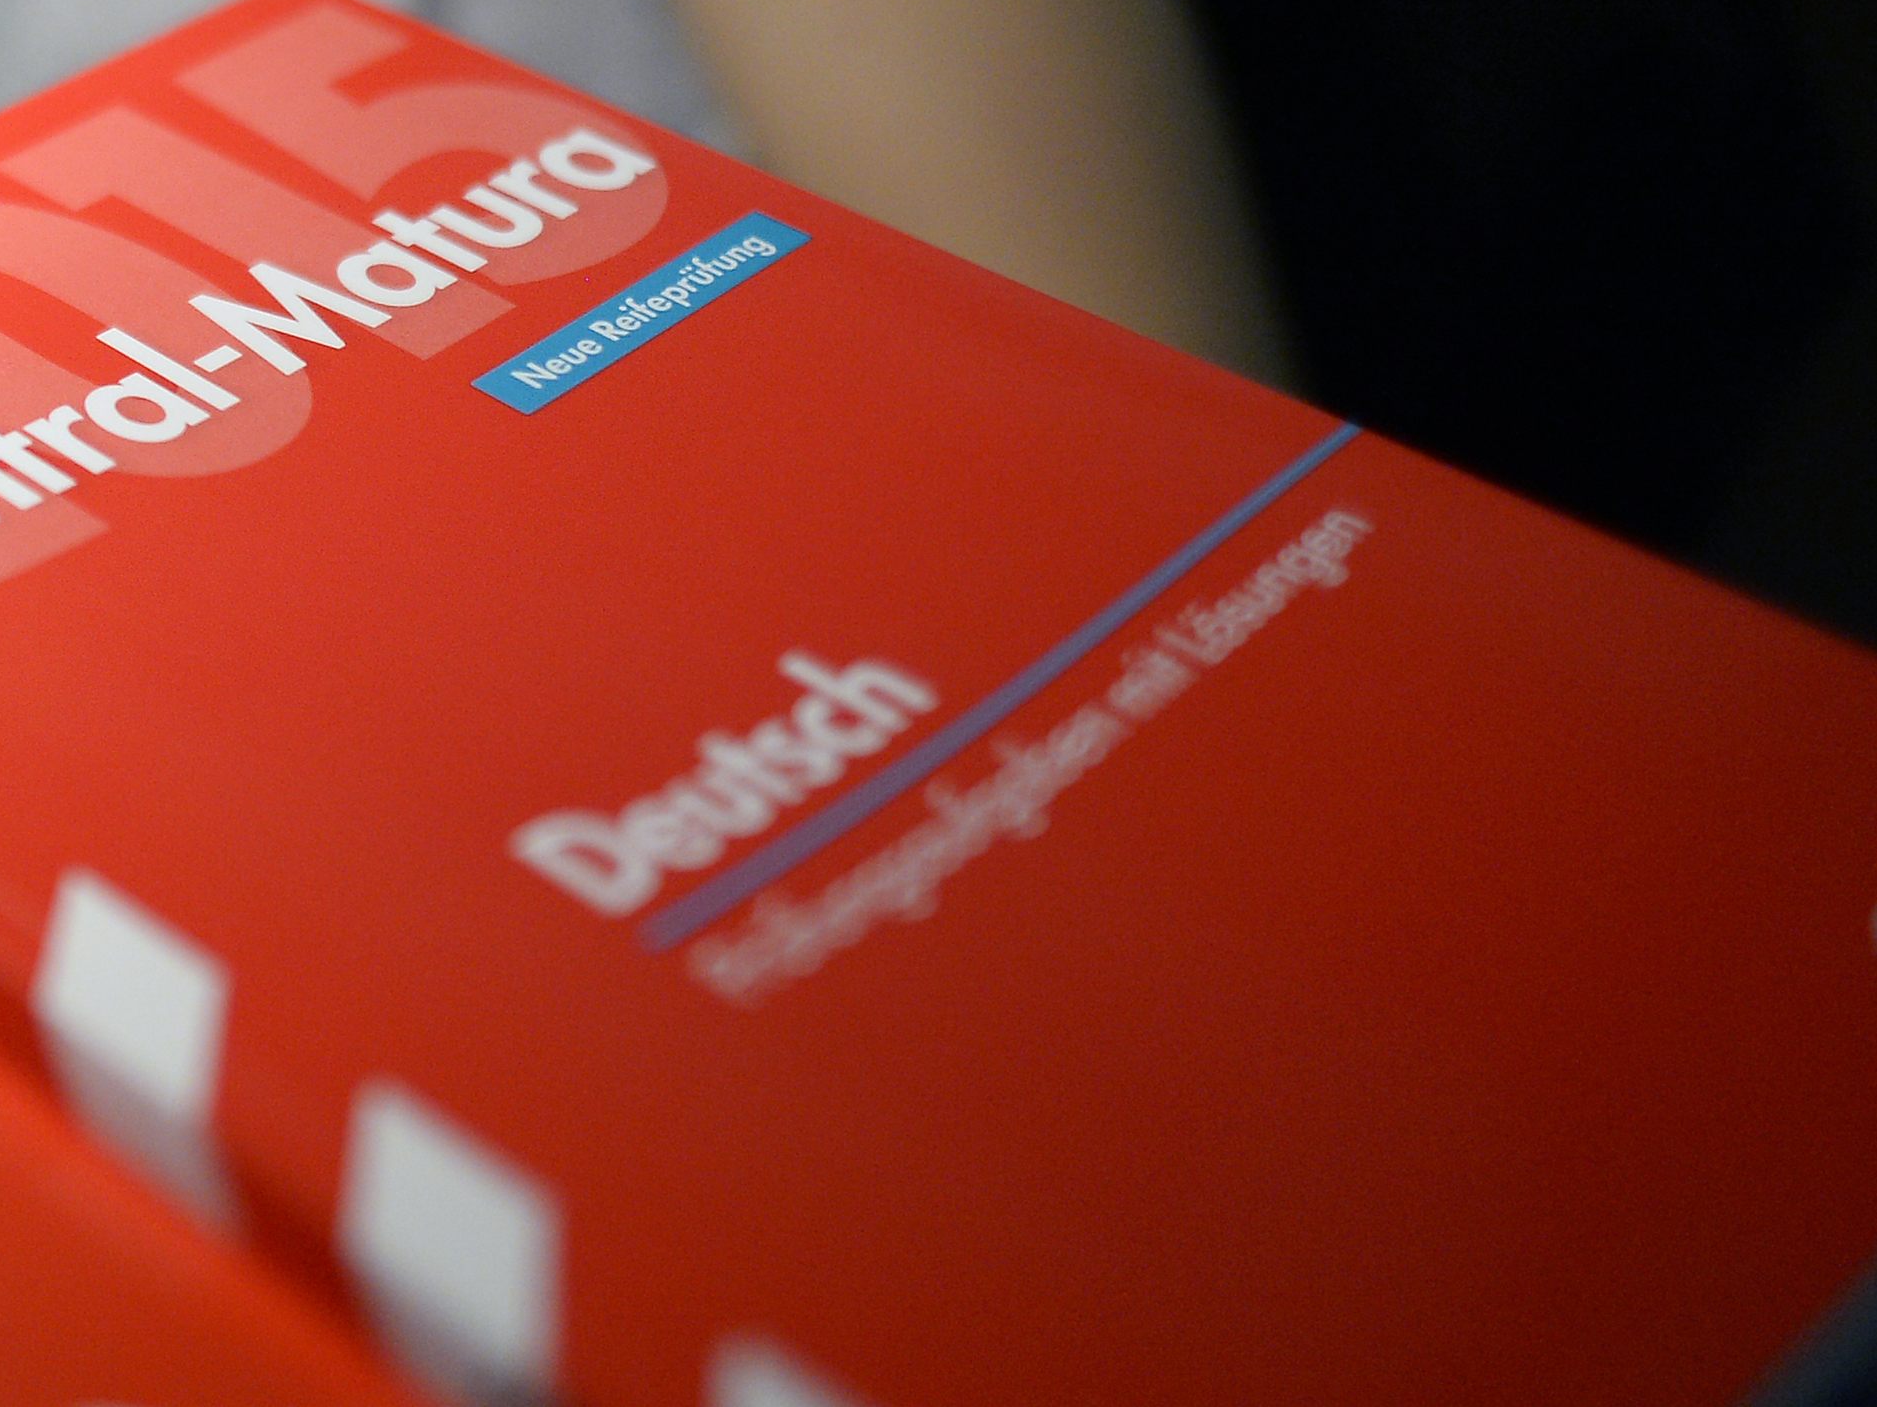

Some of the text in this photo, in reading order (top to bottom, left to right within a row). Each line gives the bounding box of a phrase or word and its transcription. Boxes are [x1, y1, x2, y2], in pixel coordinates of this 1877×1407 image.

[511, 234, 778, 389] Neue Reifeprüfung
[510, 648, 940, 914] Deutsch
